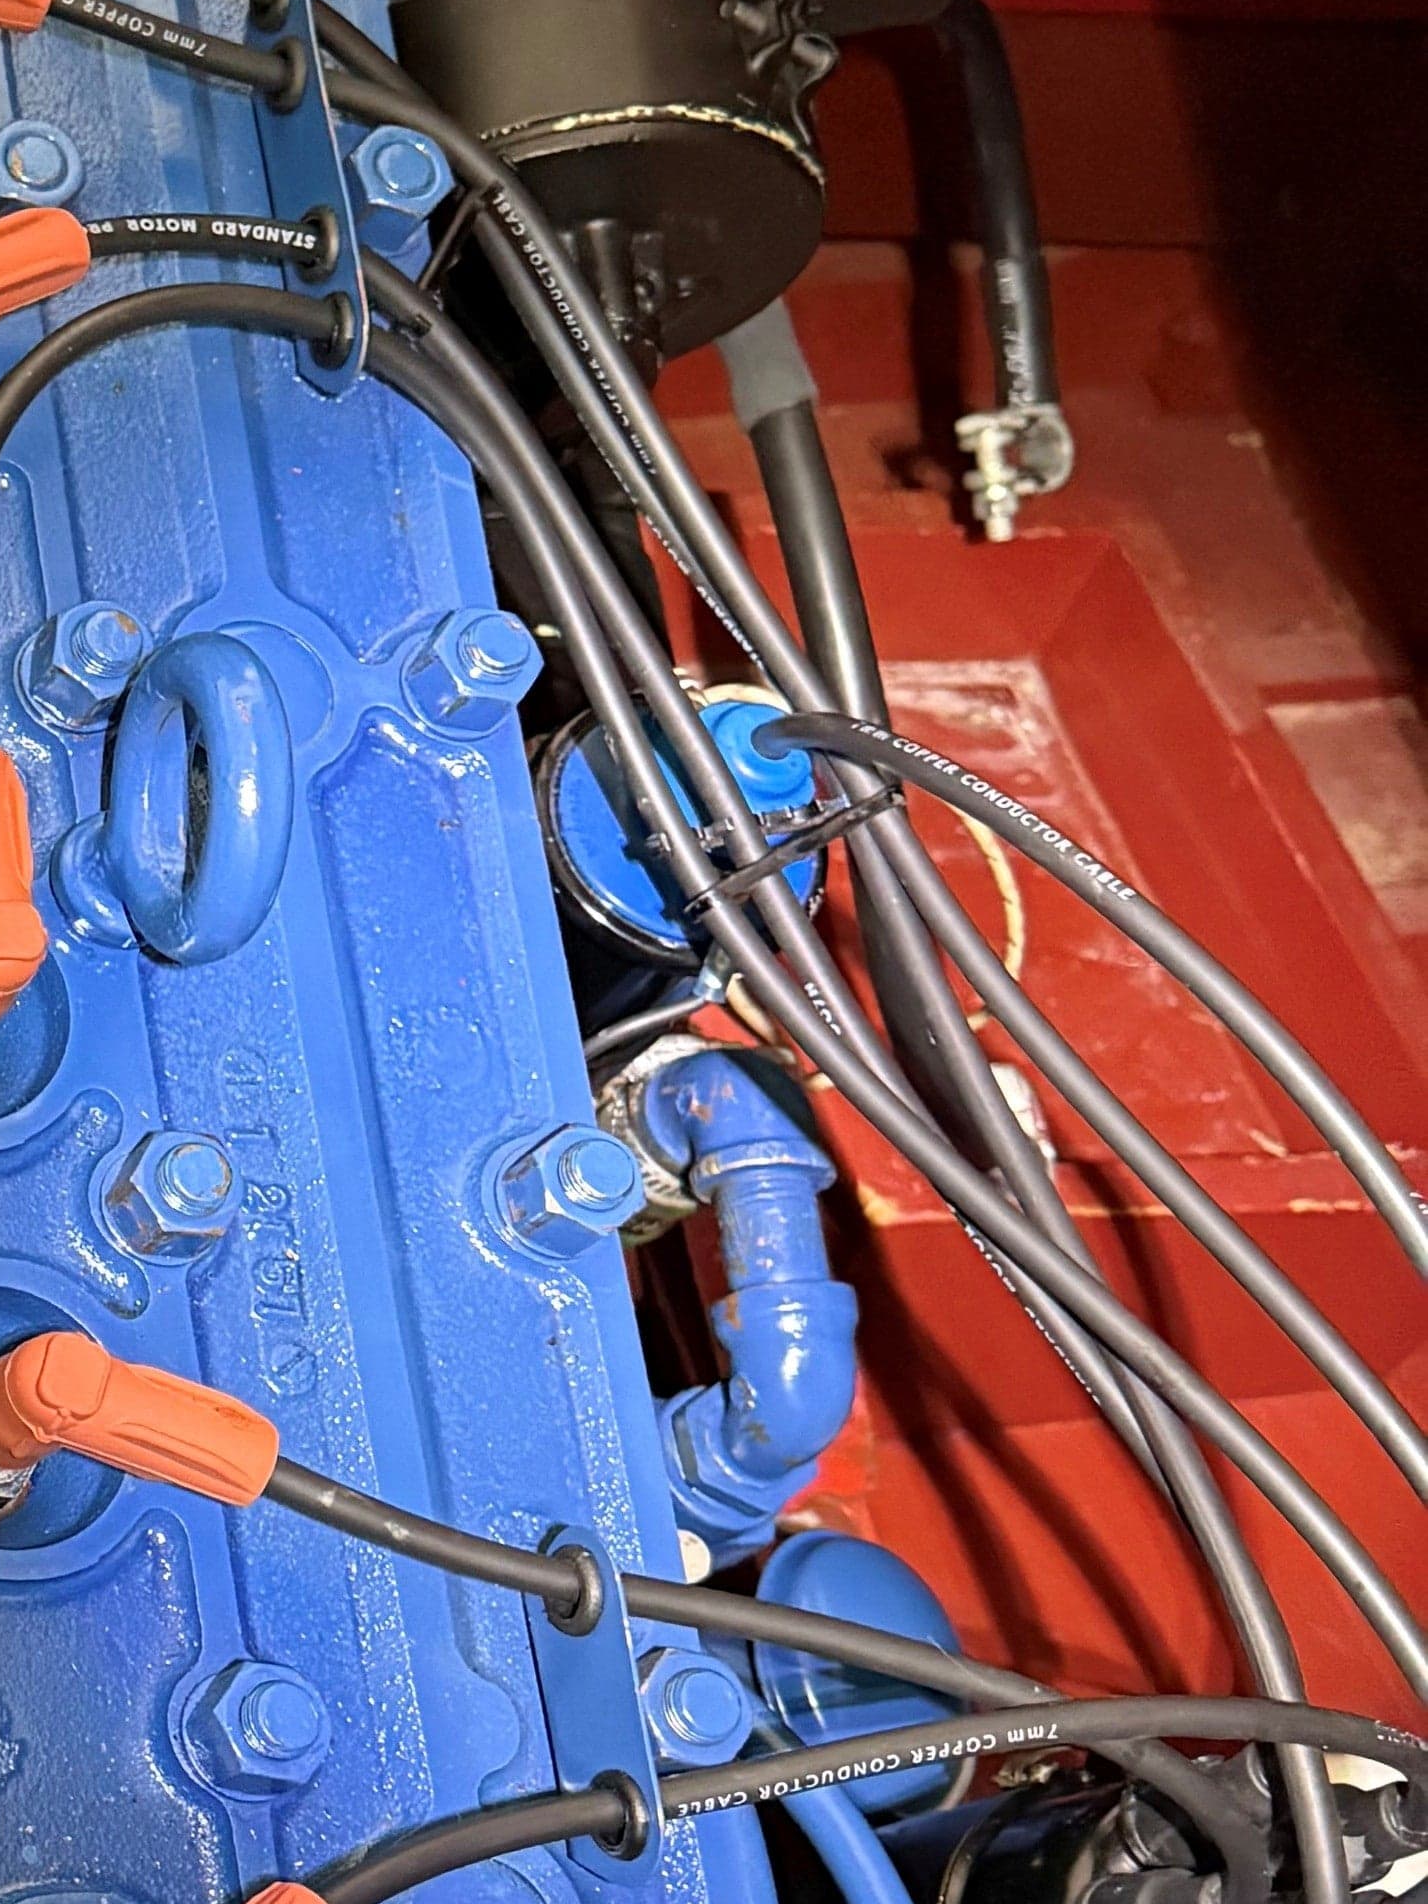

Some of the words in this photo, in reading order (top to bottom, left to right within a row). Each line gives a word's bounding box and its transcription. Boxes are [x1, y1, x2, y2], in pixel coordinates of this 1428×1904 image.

[164, 28, 209, 58] 7mm
[126, 217, 197, 233] MOTOR
[211, 219, 318, 250] STANDARD
[522, 238, 590, 353] CONDUCTOR
[892, 736, 961, 777] COPPER
[959, 772, 1074, 854] CONDUCTOR
[1073, 852, 1138, 902] CABLE
[1007, 1722, 1059, 1744] 7mm
[910, 1733, 998, 1765] COPPER
[759, 1756, 902, 1801] CONDUCTOR
[676, 1789, 748, 1818] CABLE
